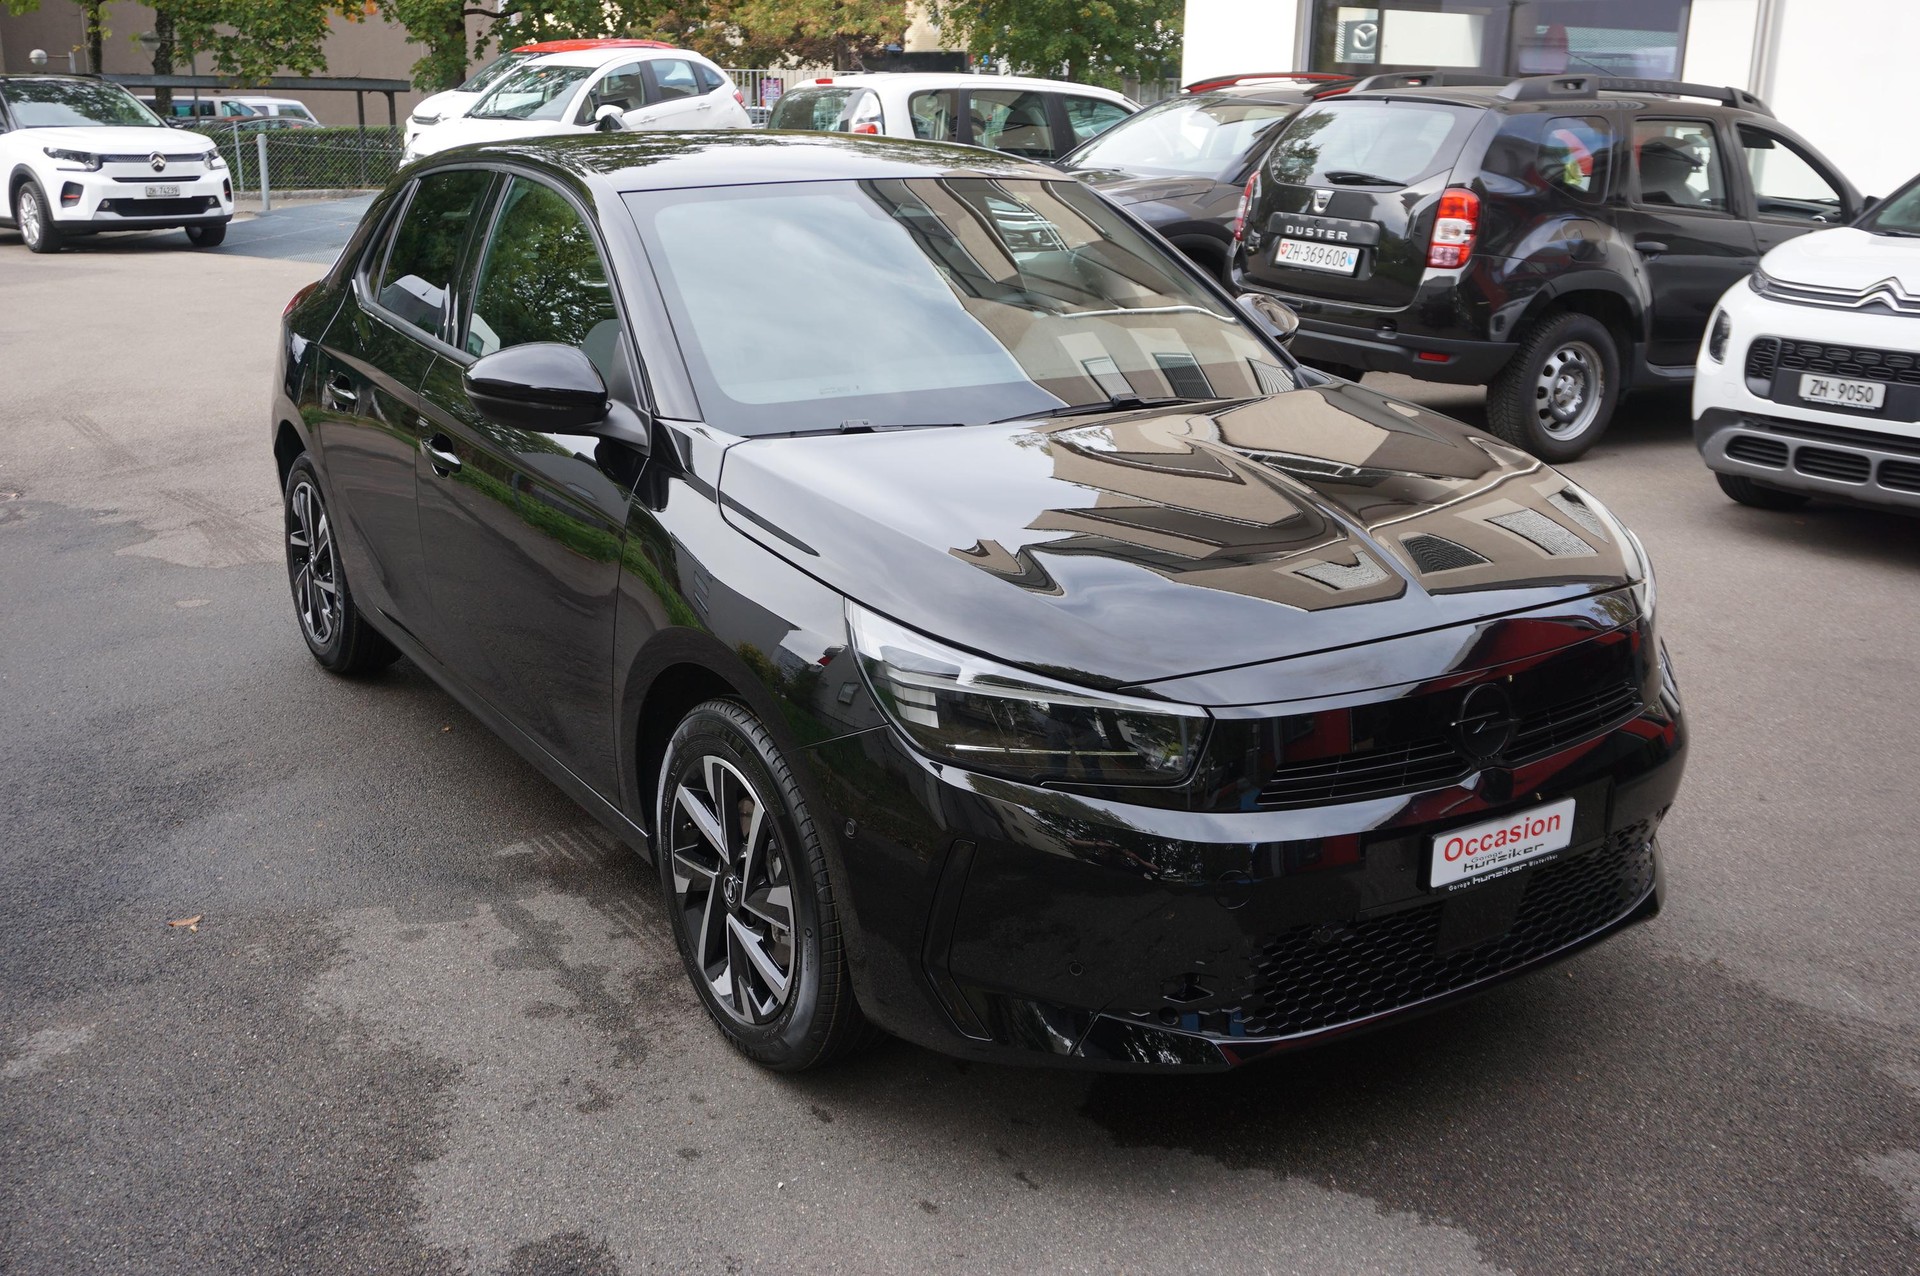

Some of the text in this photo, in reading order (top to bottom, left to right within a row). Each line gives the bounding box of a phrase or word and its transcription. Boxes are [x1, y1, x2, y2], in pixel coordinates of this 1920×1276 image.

[1286, 225, 1348, 240] DUSTER
[1444, 814, 1561, 862] Occasion
[1463, 843, 1545, 873] hunziker
[1449, 881, 1471, 891] Garage
[1472, 863, 1528, 885] hunziker
